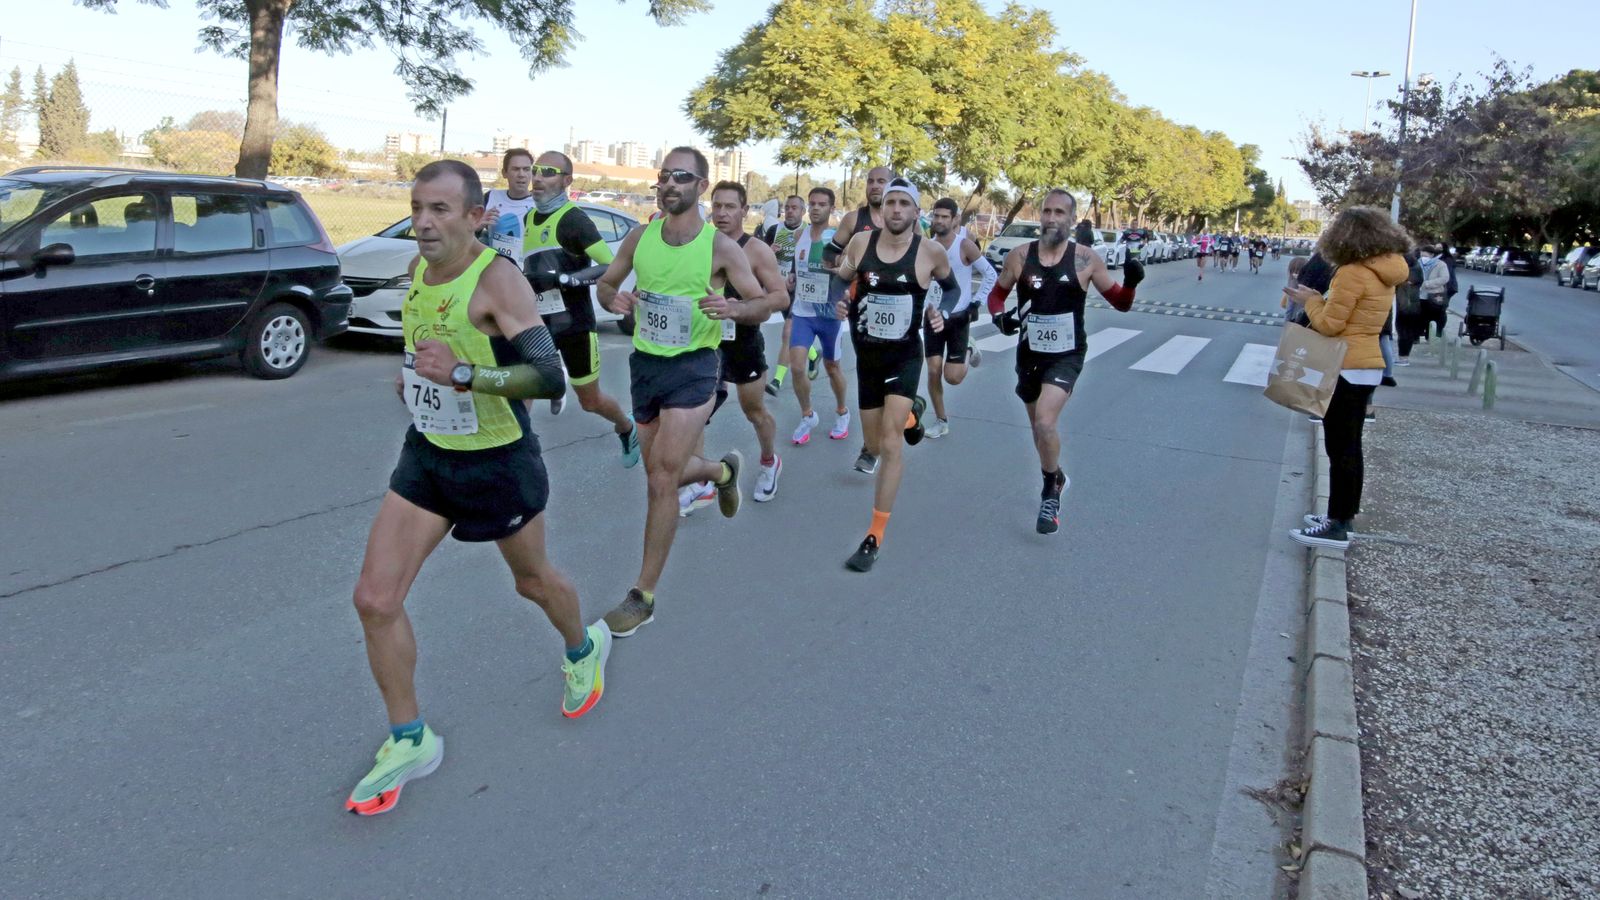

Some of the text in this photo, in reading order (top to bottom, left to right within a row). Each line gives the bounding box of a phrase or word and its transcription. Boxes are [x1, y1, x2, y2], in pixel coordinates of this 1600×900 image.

[802, 283, 816, 293] 156
[647, 311, 668, 330] 588
[874, 311, 895, 326] 260
[1036, 329, 1058, 341] 246
[412, 385, 441, 410] 745
